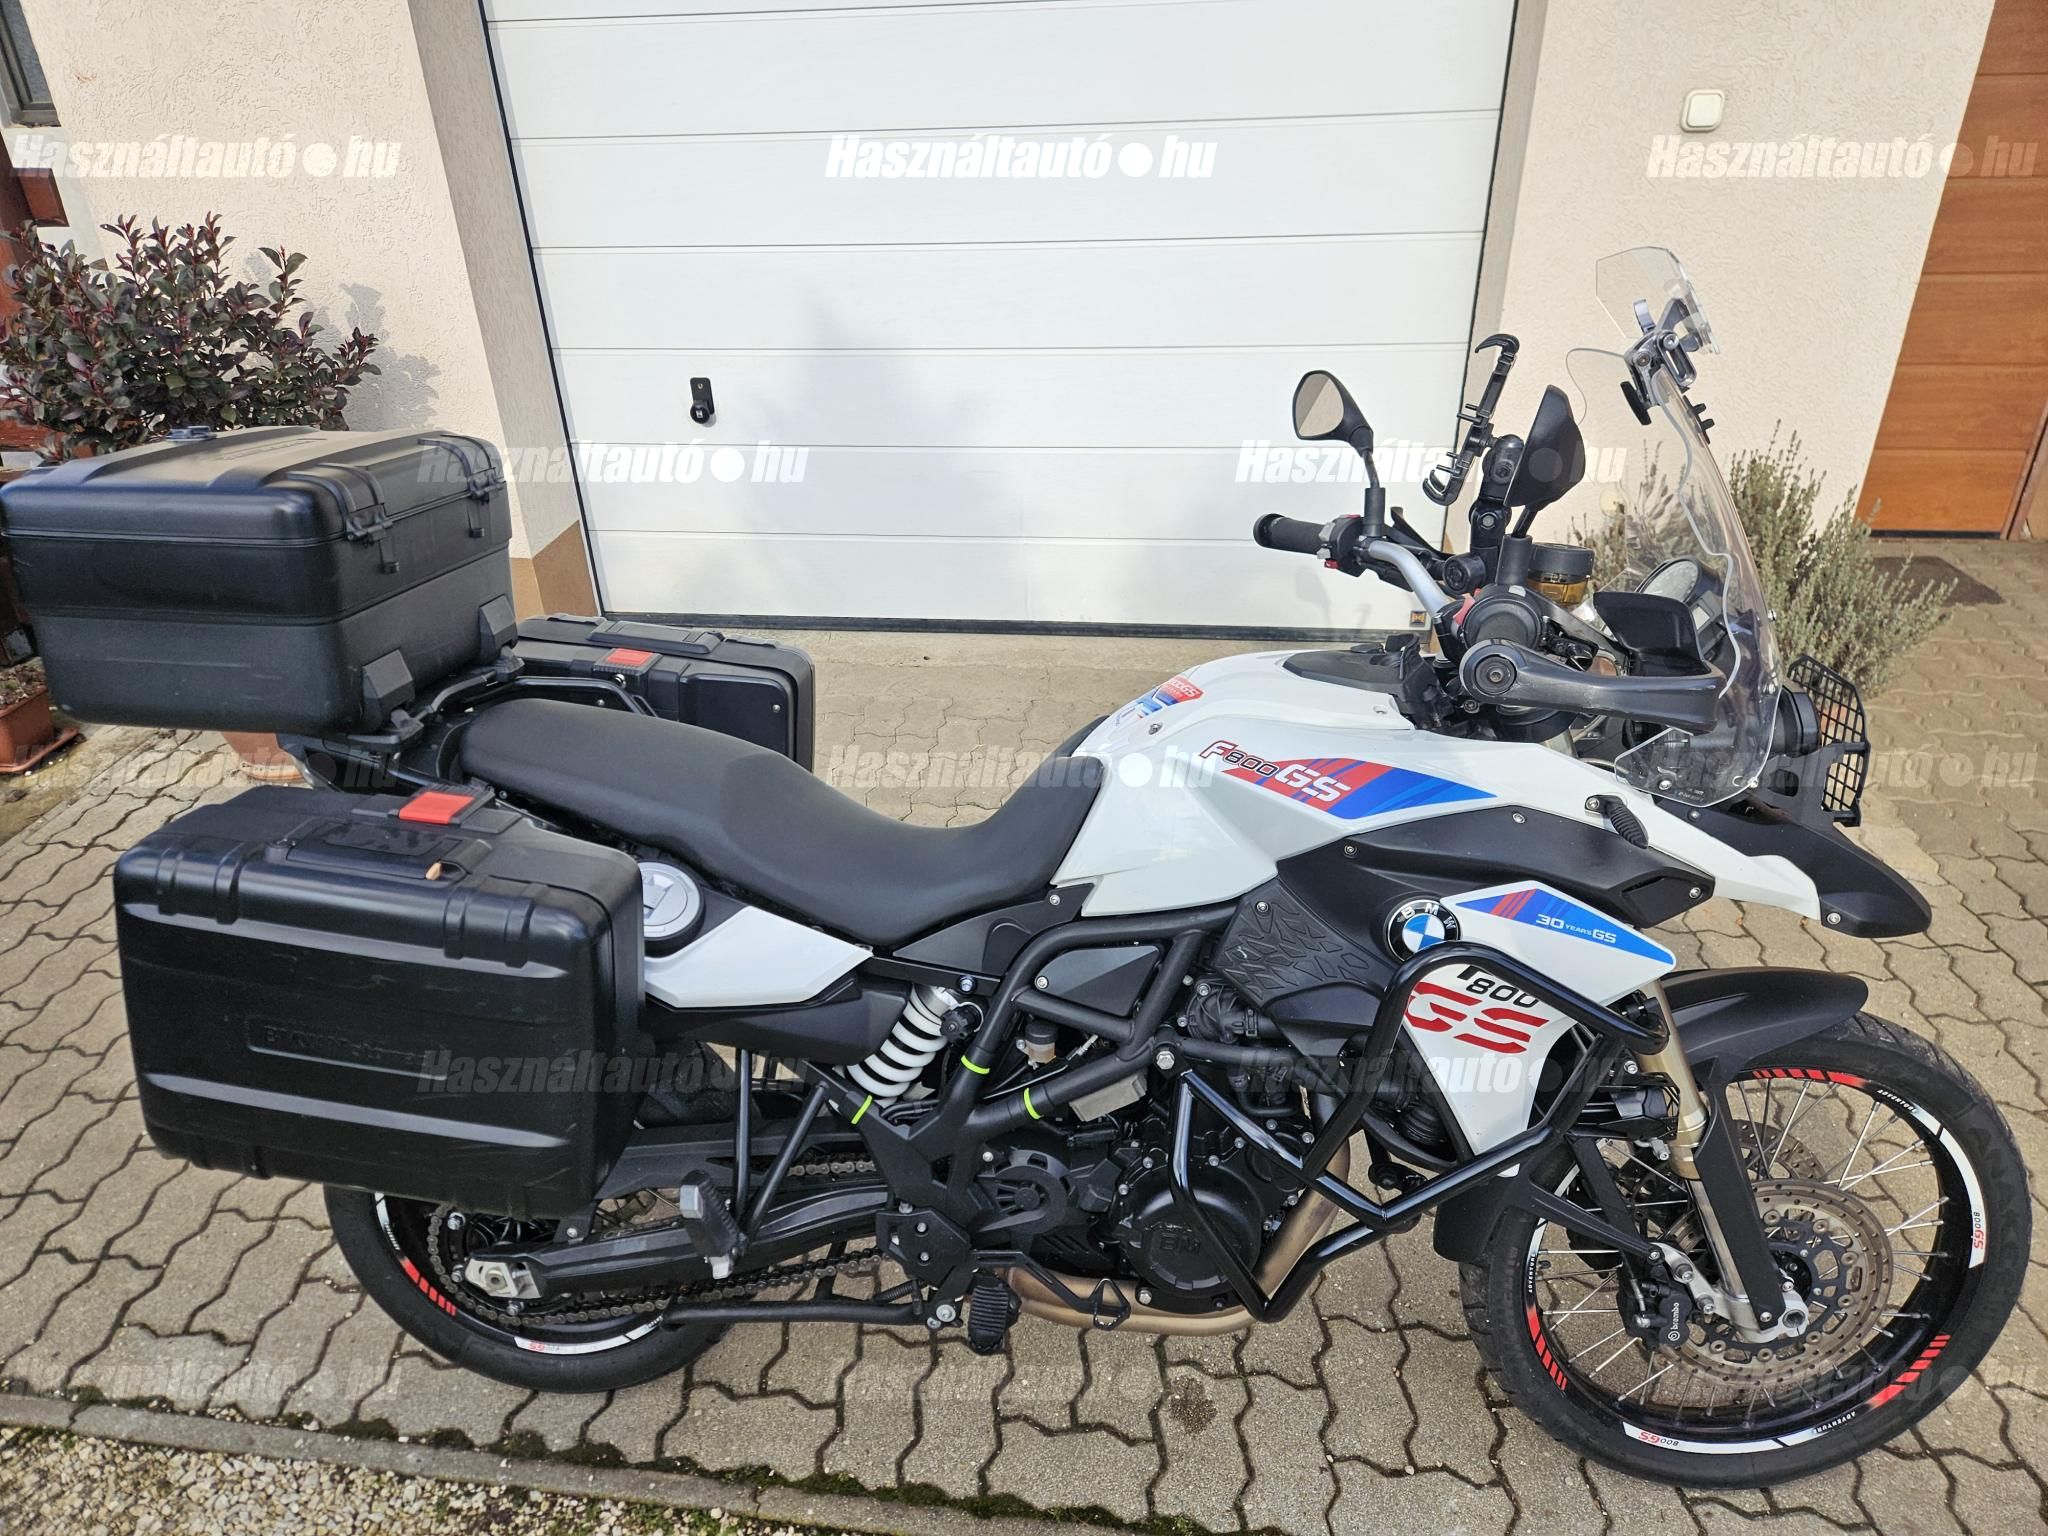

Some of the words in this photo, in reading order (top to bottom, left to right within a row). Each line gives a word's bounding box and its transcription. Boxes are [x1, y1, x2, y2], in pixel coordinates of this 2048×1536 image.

[1200, 740, 1351, 802] F800GS
[1401, 902, 1457, 930] BMW
[1535, 913, 1565, 930] 30
[1565, 923, 1592, 937] YEARS
[1592, 929, 1617, 944] GS
[1404, 981, 1549, 1054] GS
[1671, 1302, 1679, 1330] brembo
